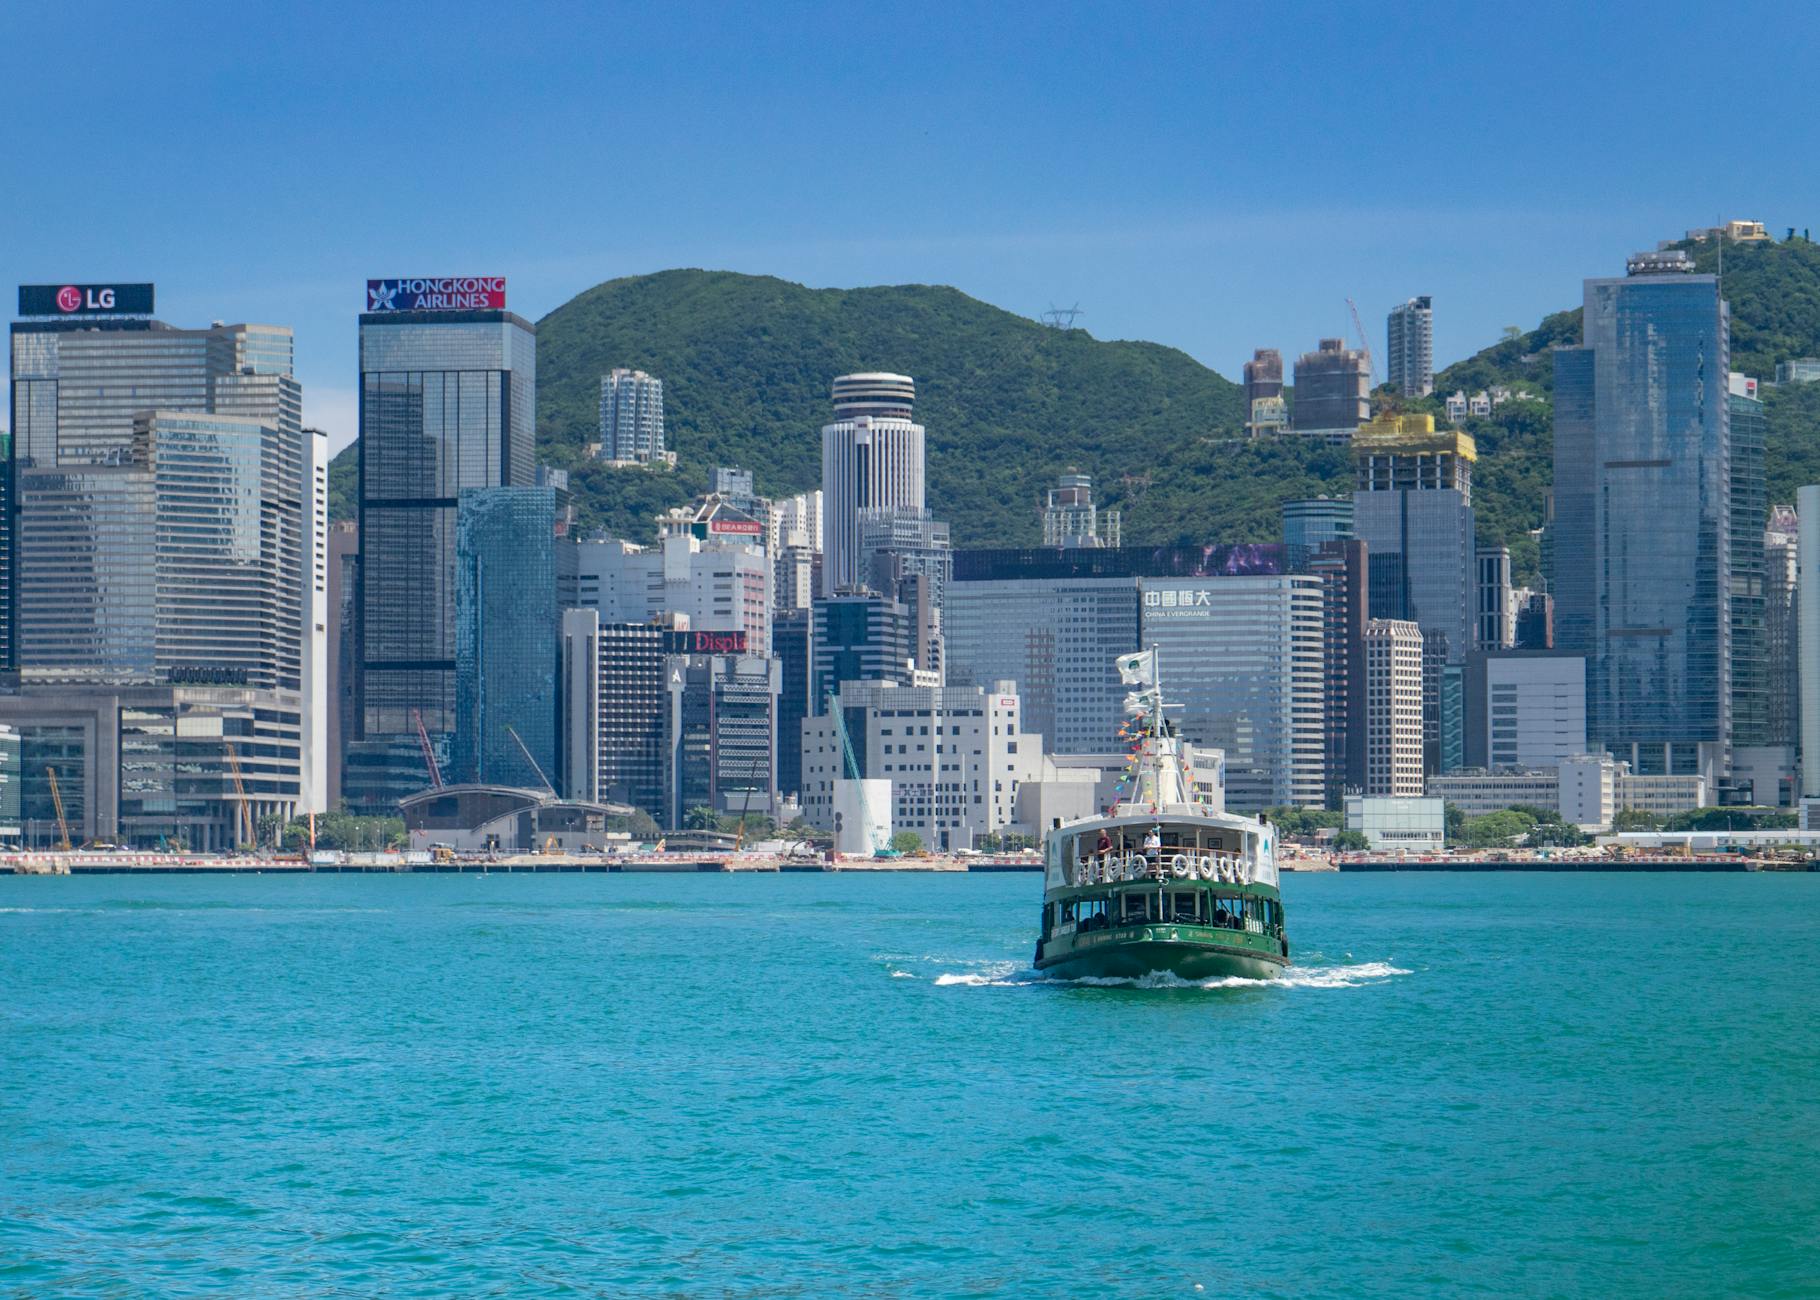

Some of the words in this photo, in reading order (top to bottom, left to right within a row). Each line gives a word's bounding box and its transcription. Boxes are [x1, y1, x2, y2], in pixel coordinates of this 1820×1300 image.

[398, 279, 505, 294] HONGKONG
[86, 288, 116, 309] LG
[414, 293, 489, 309] AIRLINES
